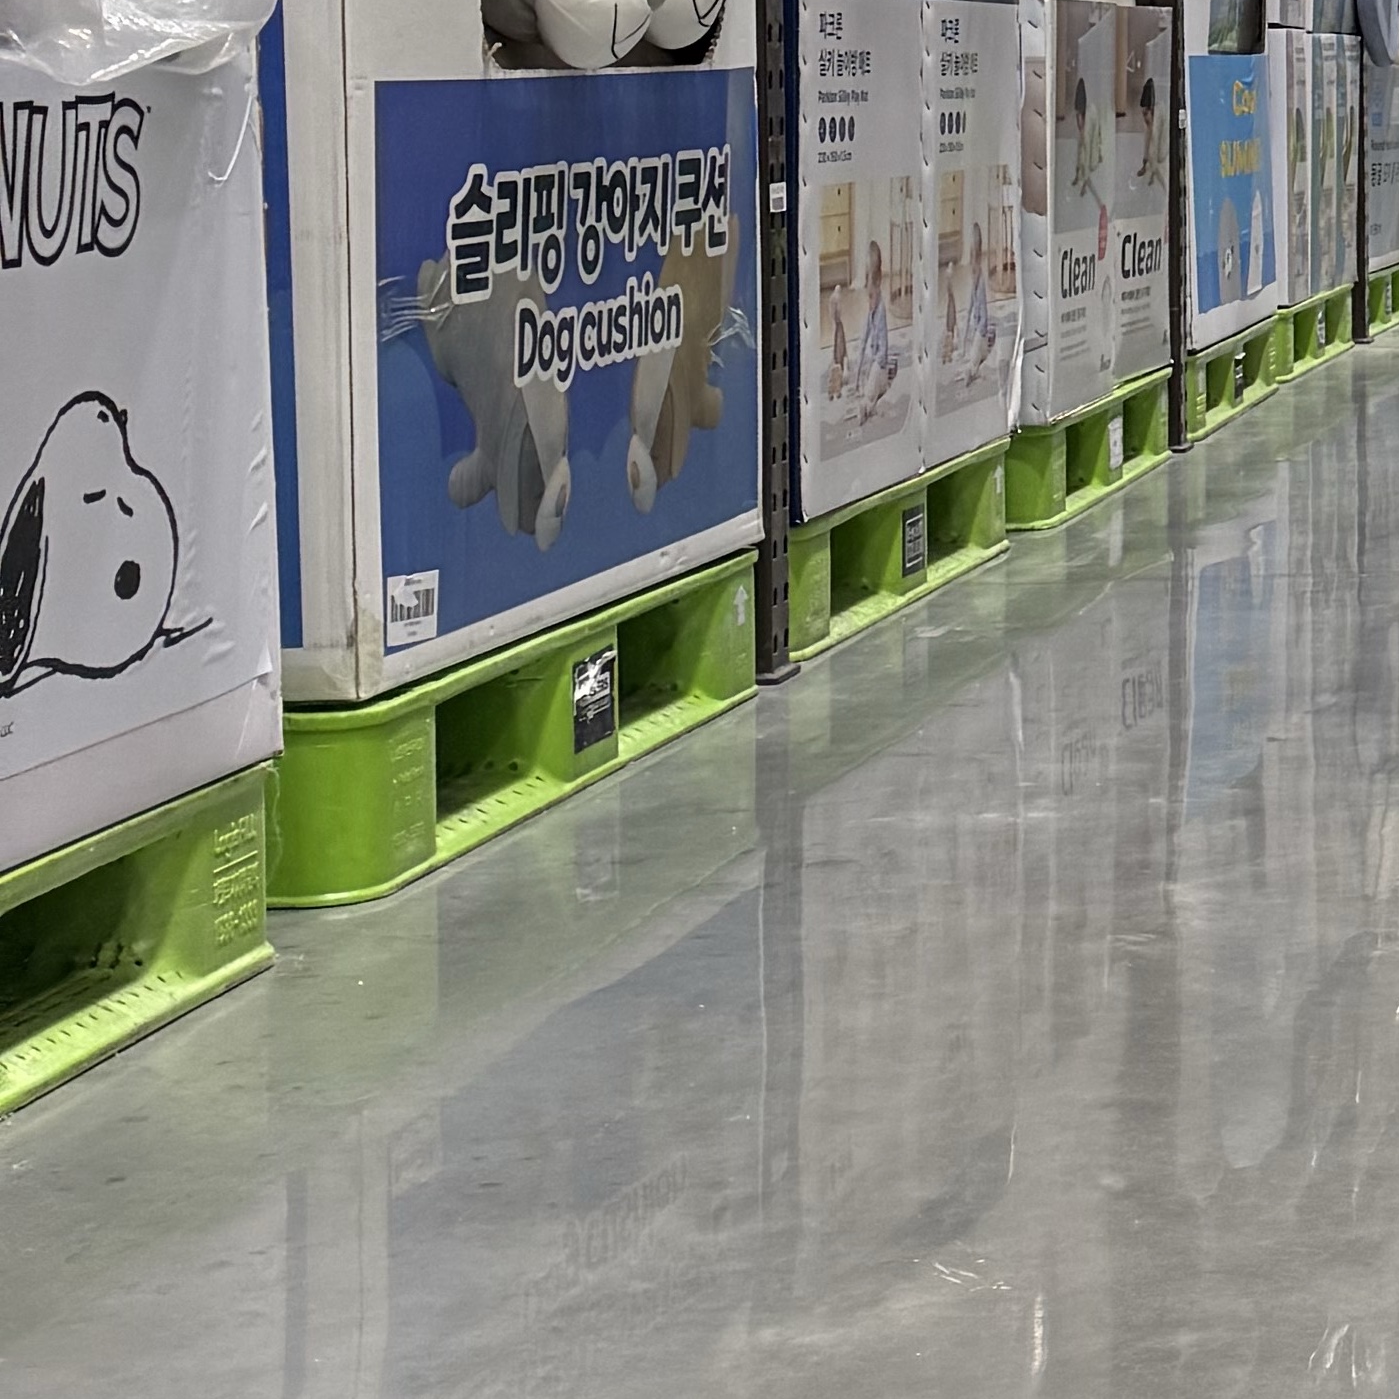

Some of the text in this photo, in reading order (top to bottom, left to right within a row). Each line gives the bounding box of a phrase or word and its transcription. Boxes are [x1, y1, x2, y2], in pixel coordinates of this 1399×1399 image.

[452, 151, 729, 295] 슬리핑 강아지 쿠션
[1121, 232, 1162, 279] Clean
[1061, 248, 1095, 299] Clean
[518, 278, 681, 383] Dog cushion
